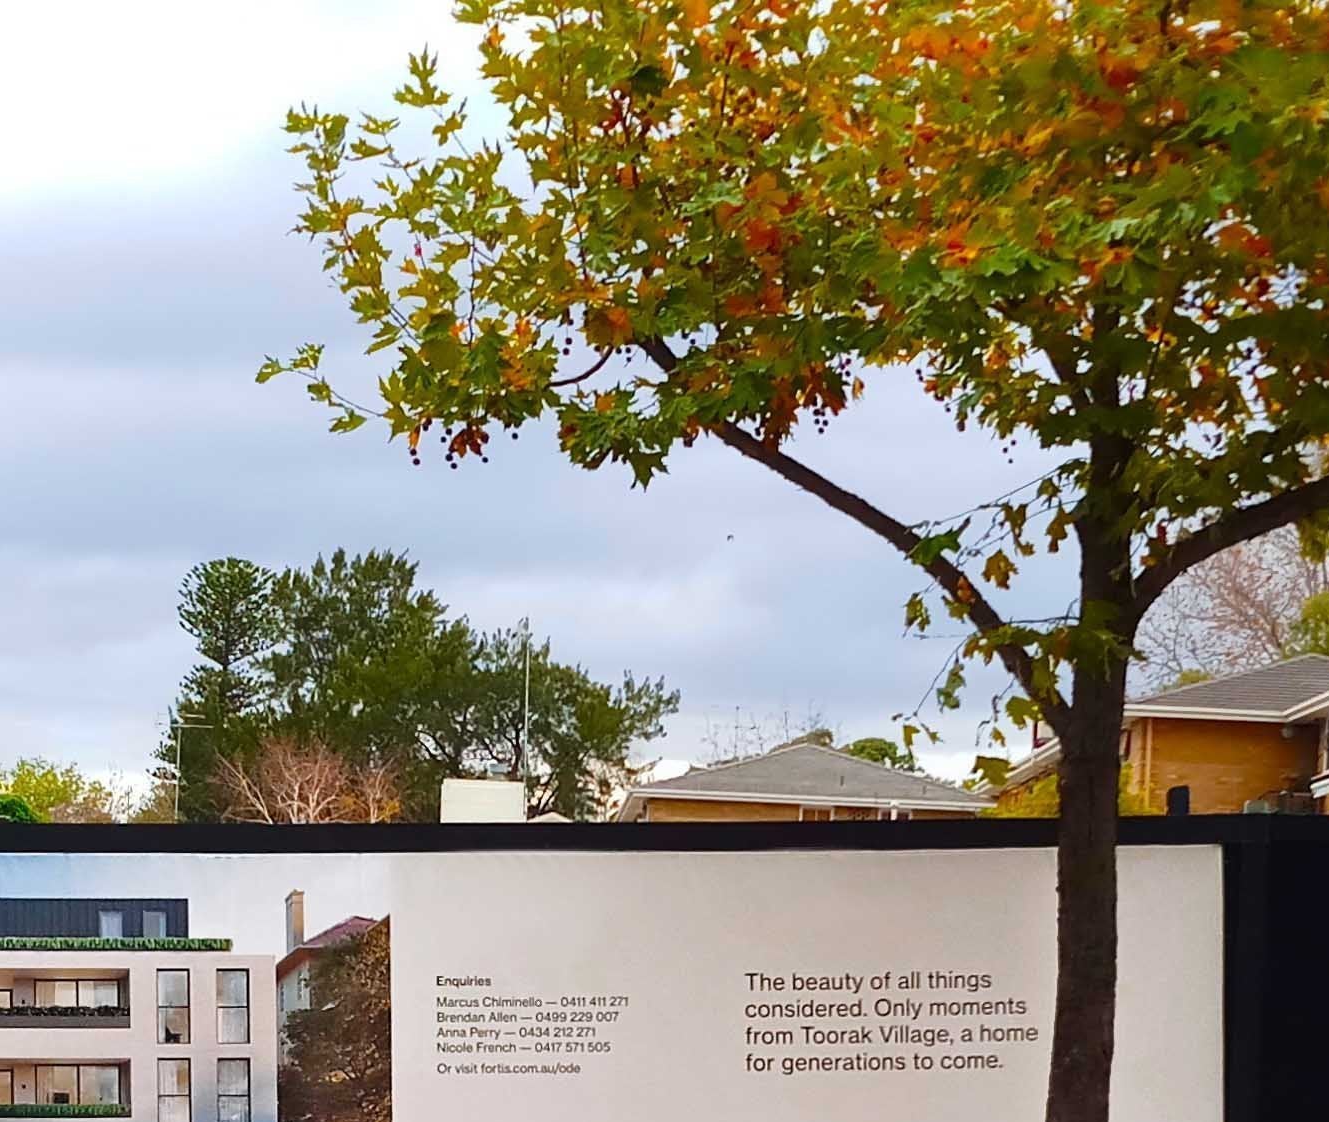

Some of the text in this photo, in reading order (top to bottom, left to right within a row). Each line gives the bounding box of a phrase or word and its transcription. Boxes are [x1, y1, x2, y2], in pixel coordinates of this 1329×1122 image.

[436, 975, 492, 989] Enquiries
[744, 970, 992, 995] The beauty of all things
[436, 996, 480, 1008] Marcus
[482, 996, 543, 1008] Chiminello
[560, 996, 587, 1008] 0411
[588, 996, 607, 1007] 411
[609, 995, 629, 1007] 271
[744, 997, 1027, 1021] considered. Only moments
[436, 1011, 486, 1023] Brendan
[488, 1011, 518, 1023] Allen
[535, 1011, 568, 1023] 0499
[569, 1011, 594, 1023] 229
[595, 1010, 620, 1023] 007
[436, 1026, 467, 1038] Anna
[469, 1026, 502, 1041] Perry
[518, 1026, 550, 1039] 0434
[553, 1026, 574, 1038] 212
[575, 1026, 596, 1038] 271
[745, 1023, 1039, 1048] from Toorak Village, a home
[436, 1041, 474, 1054] Nicole
[475, 1041, 517, 1054] French
[534, 1041, 563, 1053] 0417
[565, 1041, 585, 1053] 571
[587, 1041, 611, 1053] 505
[436, 1062, 582, 1075] Or visit fortis.com.au/ode
[745, 1052, 1004, 1076] for generations to come.
